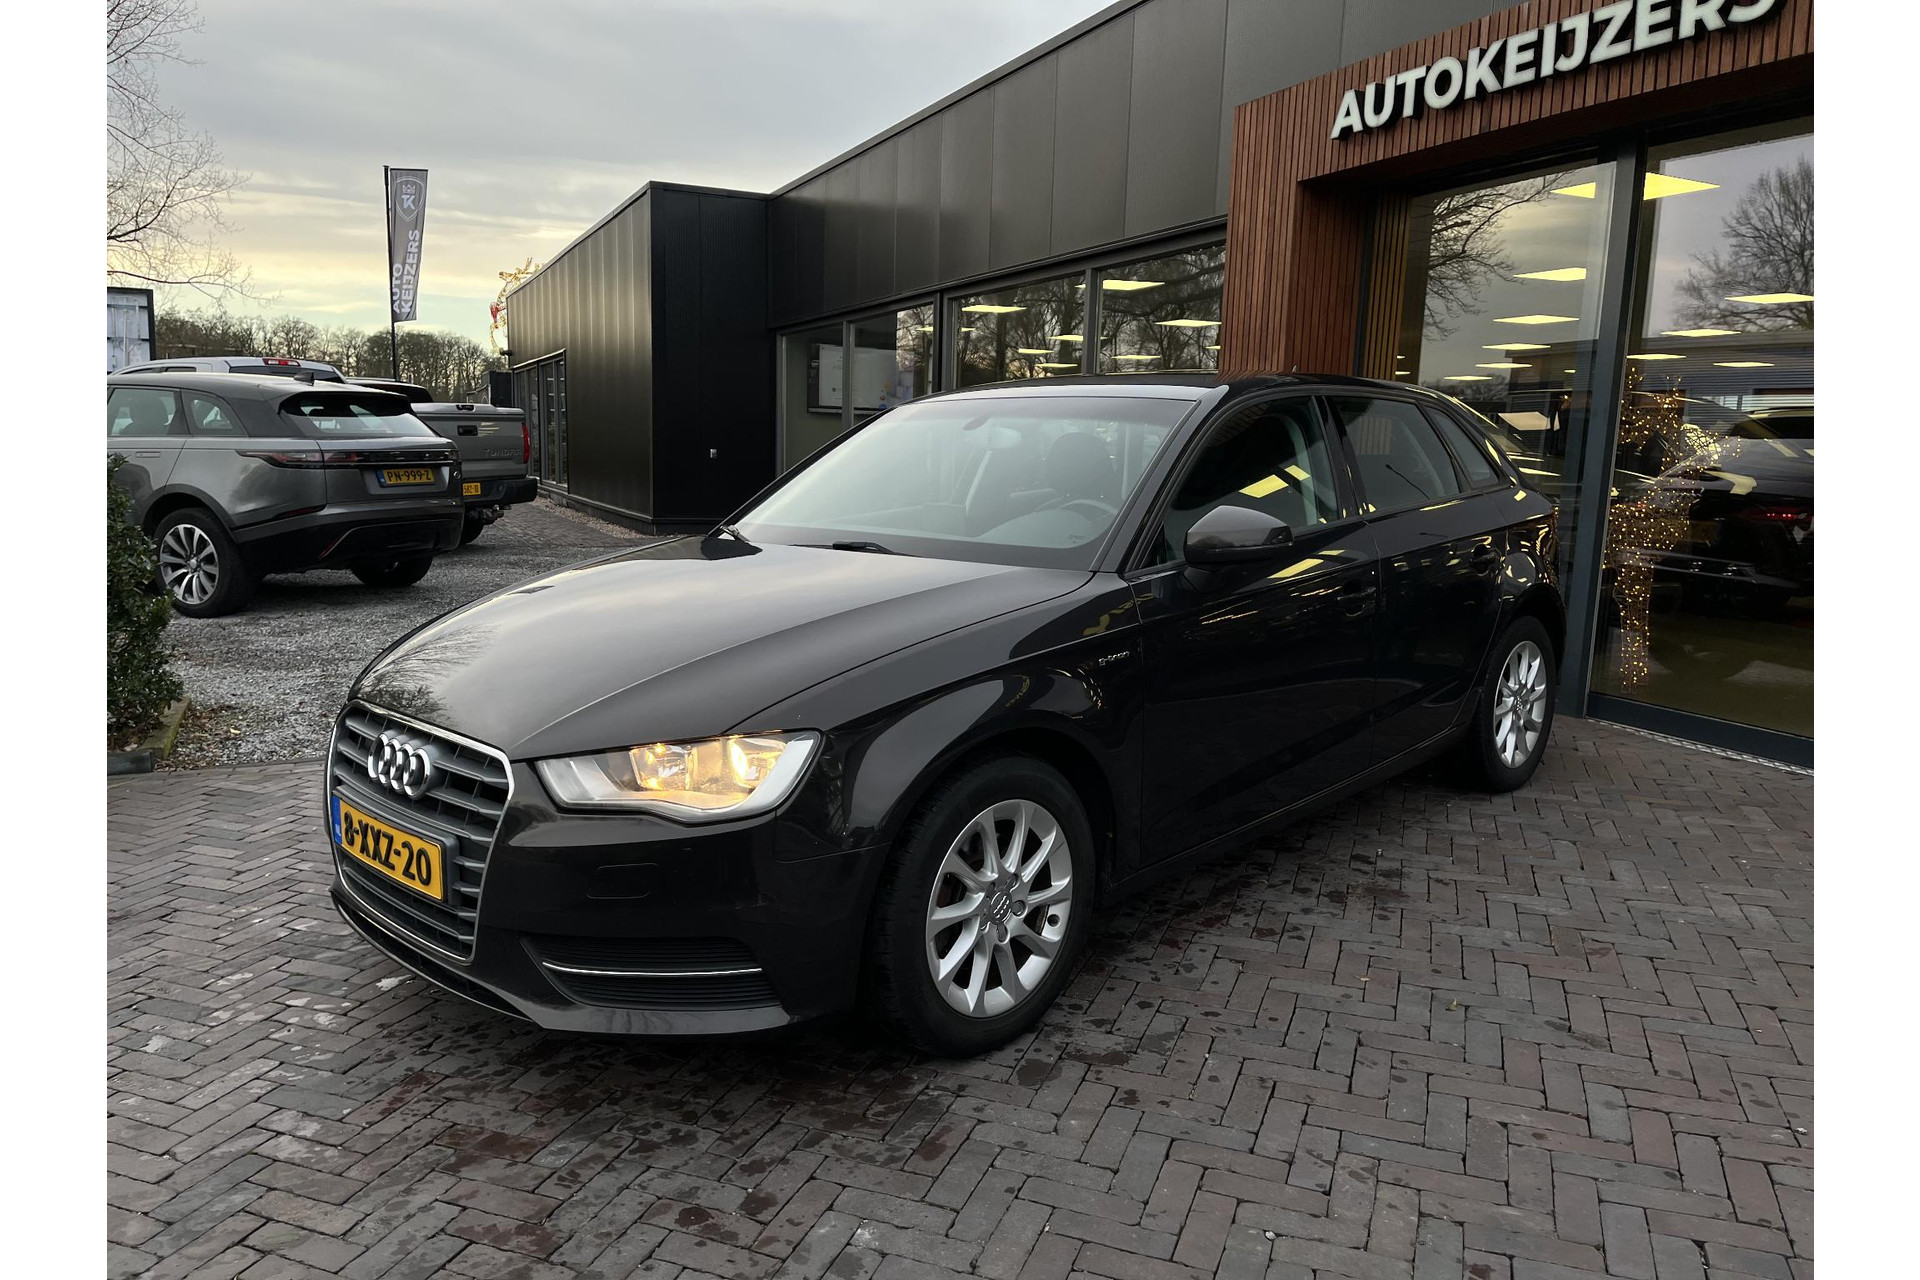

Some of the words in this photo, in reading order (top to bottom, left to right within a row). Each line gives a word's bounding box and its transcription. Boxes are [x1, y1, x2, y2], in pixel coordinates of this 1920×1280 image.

[392, 263, 403, 314] AUTO
[401, 229, 420, 313] KEIJZERS
[386, 469, 432, 482] PN-999-Z
[344, 811, 432, 887] 8-XXZ-20
